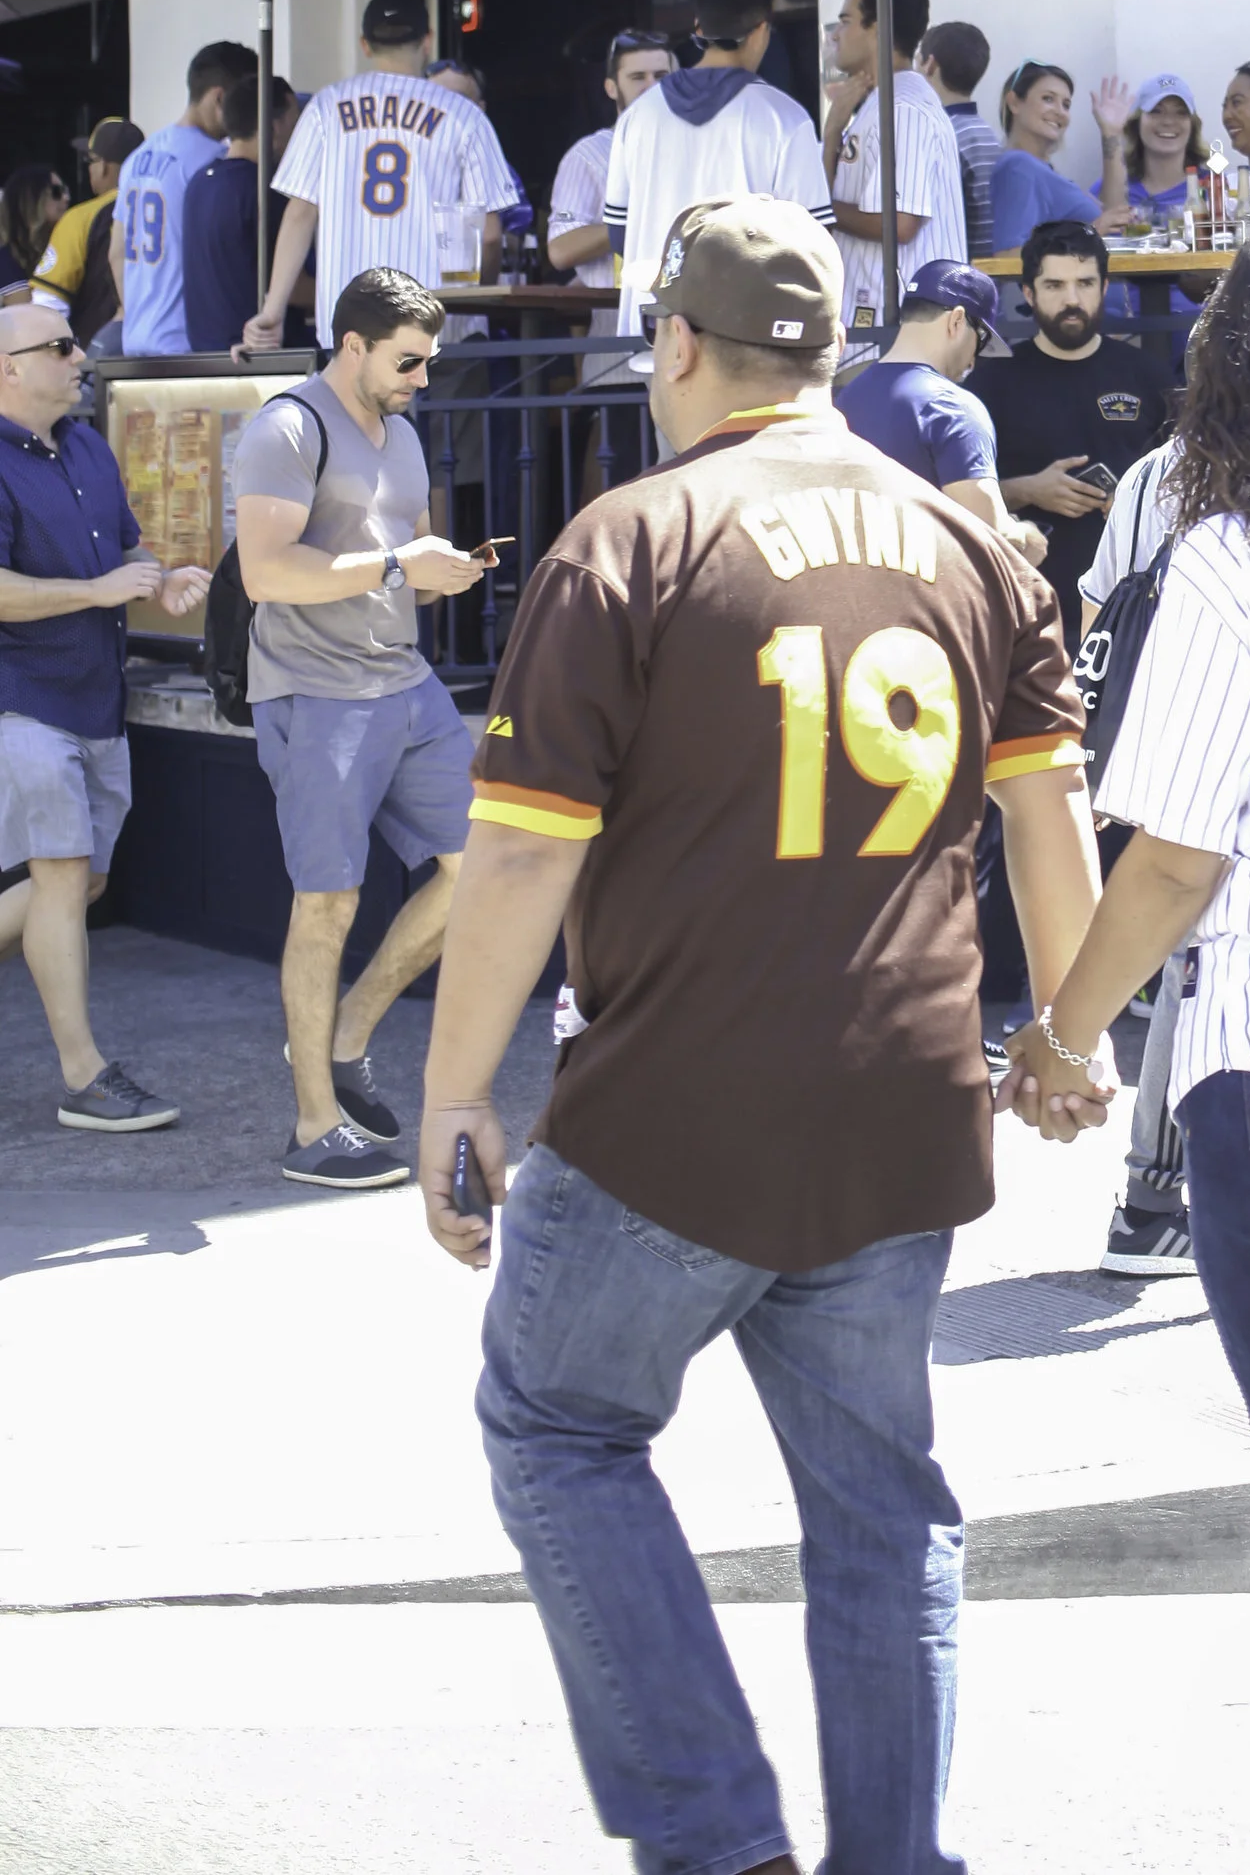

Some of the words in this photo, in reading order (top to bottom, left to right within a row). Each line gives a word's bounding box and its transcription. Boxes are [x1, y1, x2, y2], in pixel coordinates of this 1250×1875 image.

[338, 95, 445, 140] BRAUN
[361, 139, 411, 217] 8
[124, 187, 168, 265] 19
[740, 486, 937, 584] GWYNN
[757, 625, 961, 859] 19
